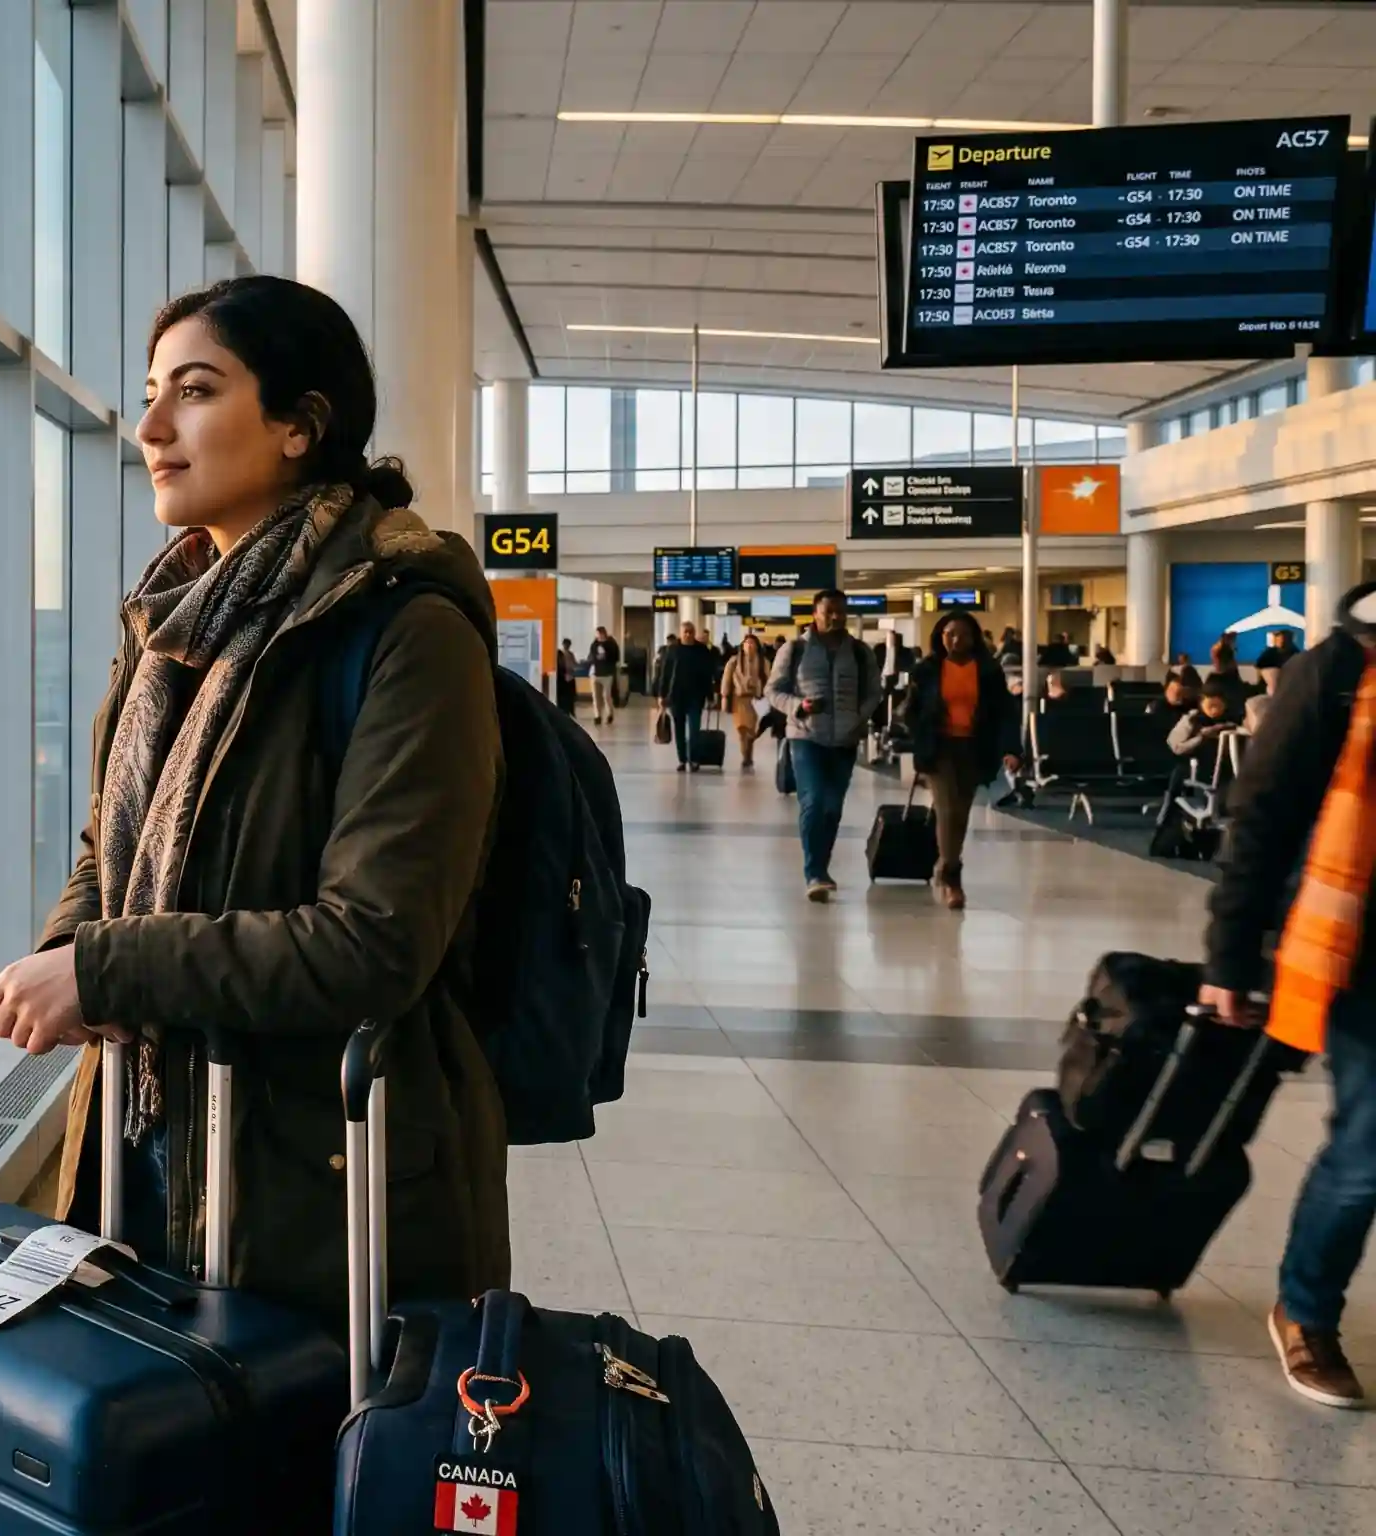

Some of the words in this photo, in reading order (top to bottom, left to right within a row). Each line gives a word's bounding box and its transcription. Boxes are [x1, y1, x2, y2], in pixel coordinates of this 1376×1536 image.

[1276, 130, 1329, 148] AC57
[958, 146, 1051, 165] Departure
[1028, 194, 1077, 207] Toronto
[1234, 186, 1255, 198] ON
[1260, 184, 1292, 197] TIME
[923, 221, 955, 233] 17:30
[1027, 217, 1076, 229] Toronto
[1166, 211, 1202, 224] 17:30
[1233, 209, 1254, 221] ON
[1258, 207, 1290, 220] TIME
[922, 244, 954, 256] 17:30
[1025, 240, 1075, 252] Toronto
[1165, 234, 1200, 247] 17:30
[1231, 232, 1253, 244] ON
[1256, 230, 1289, 243] TIME
[920, 288, 951, 300] 17:30
[491, 528, 550, 554] G54
[438, 1463, 517, 1488] CANADA
